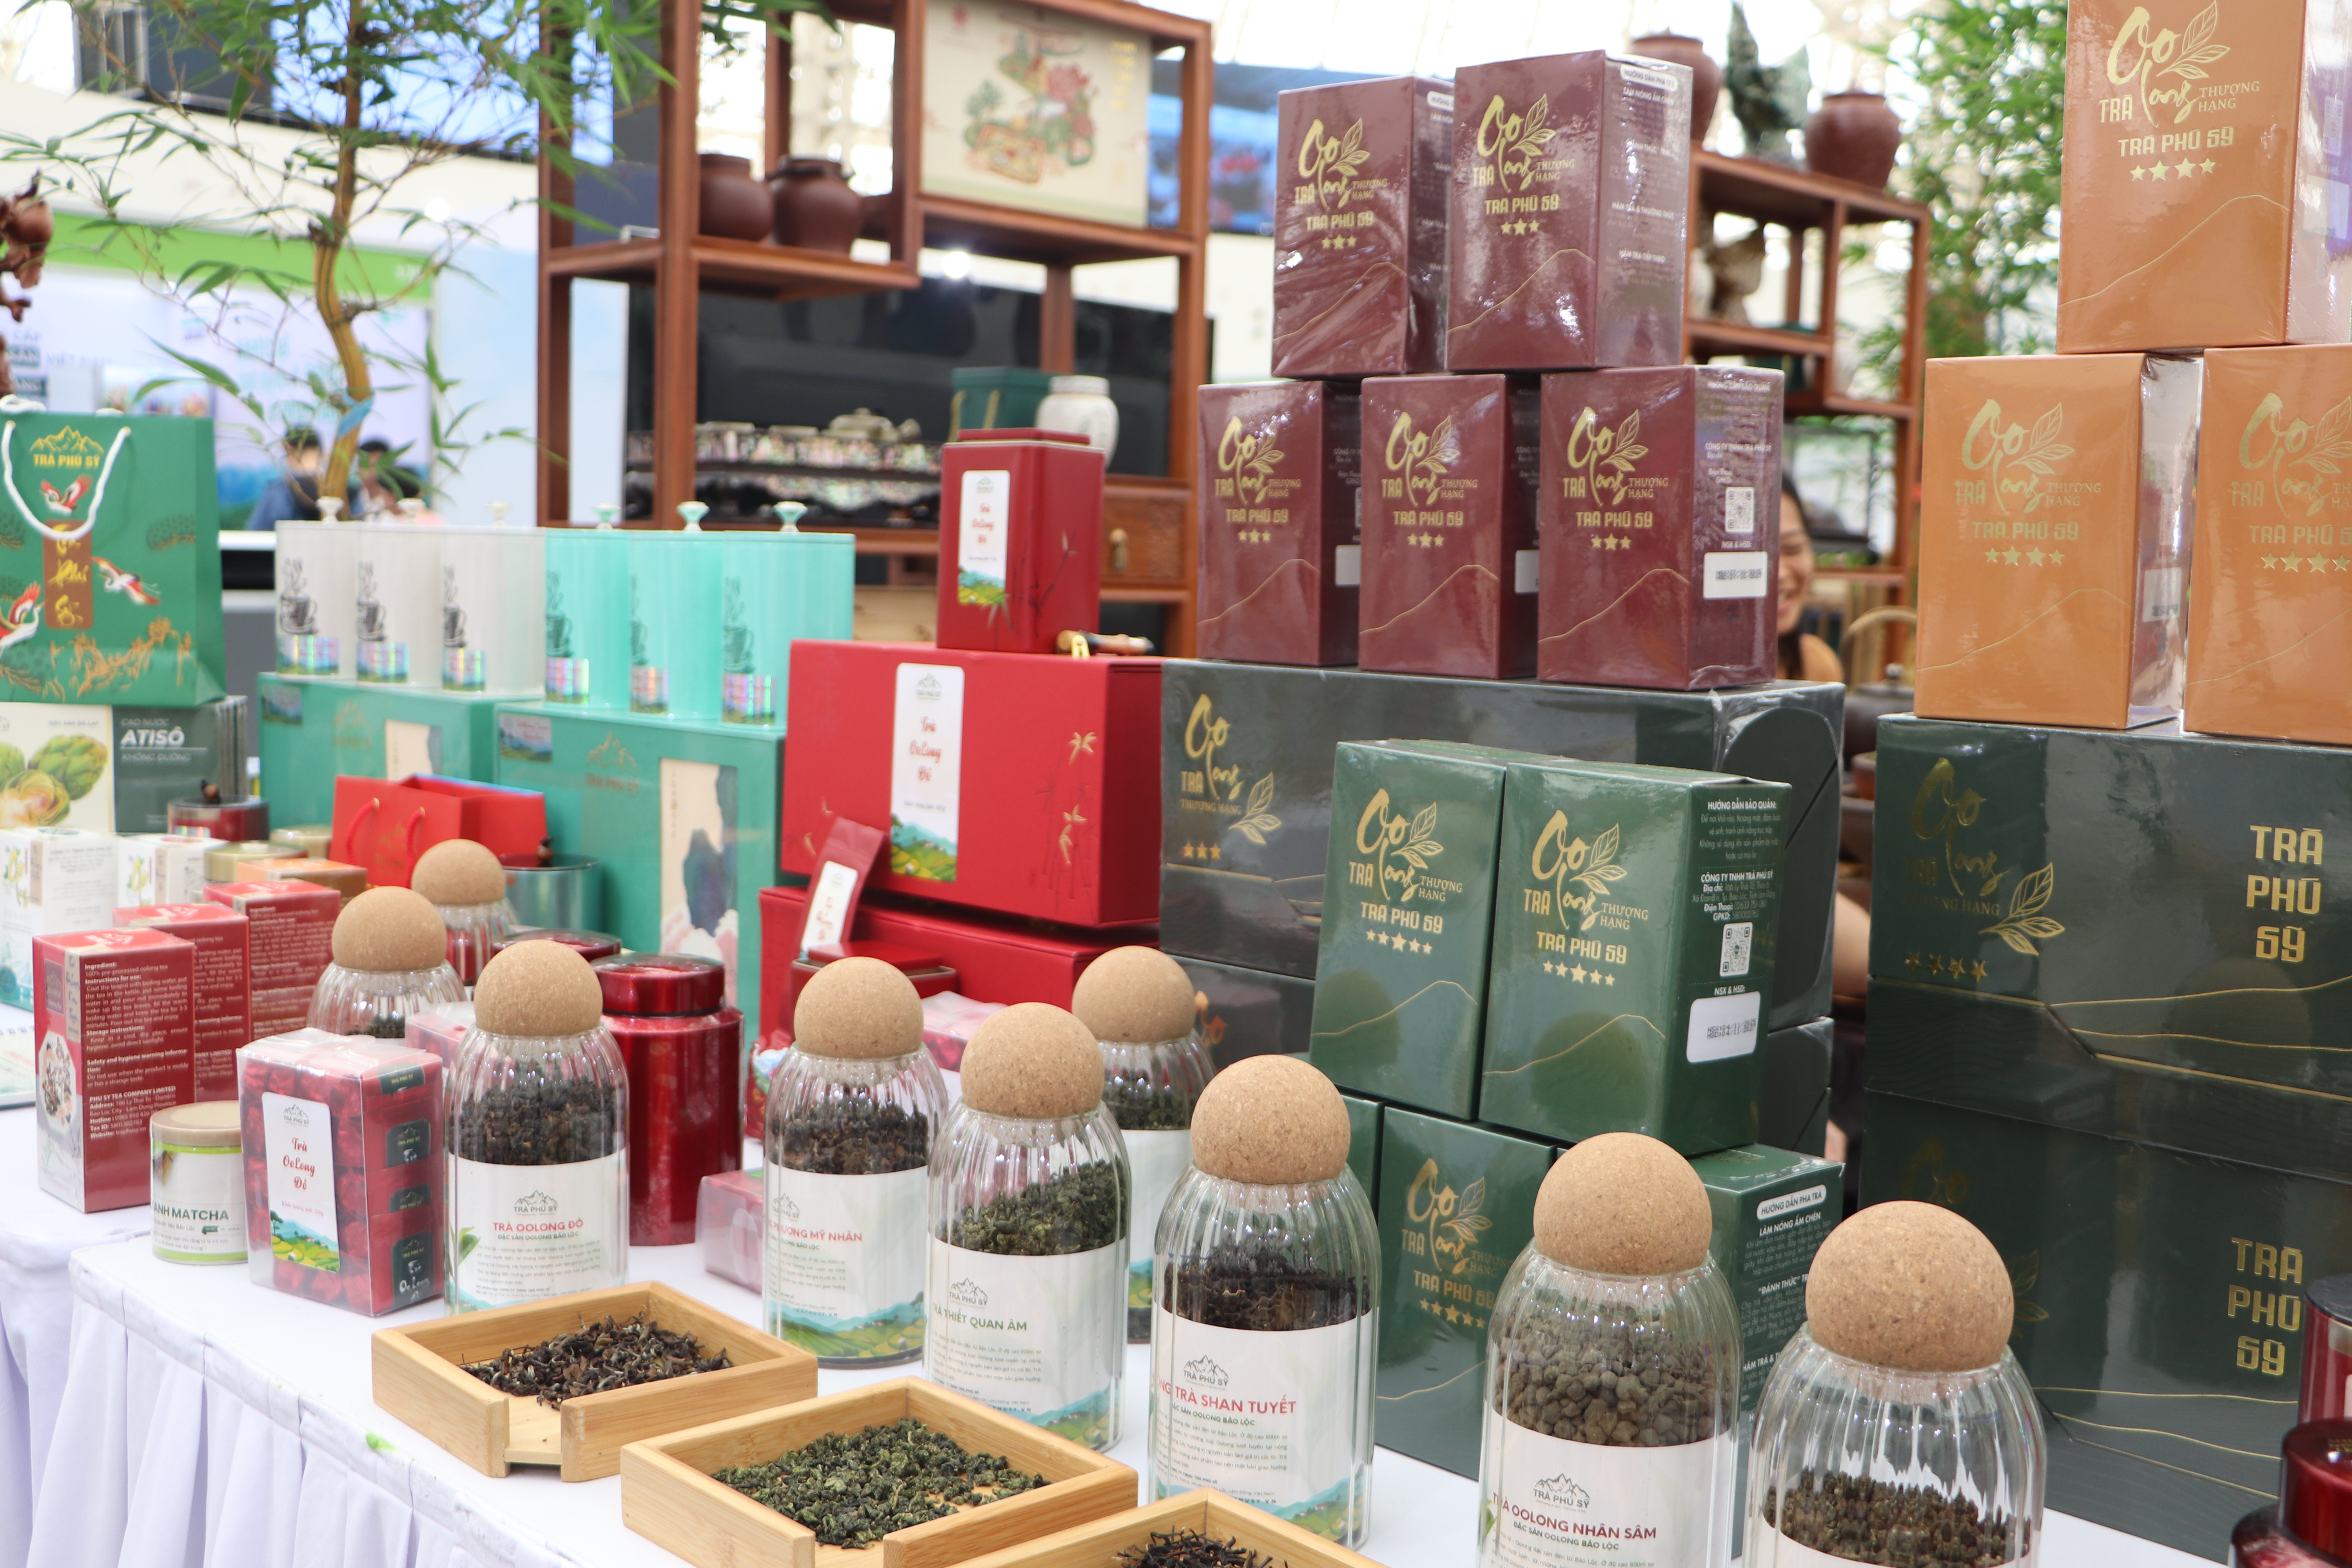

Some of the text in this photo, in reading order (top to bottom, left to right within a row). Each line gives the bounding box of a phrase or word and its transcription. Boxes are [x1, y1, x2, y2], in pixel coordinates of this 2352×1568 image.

[2199, 81, 2260, 98] THƯỢNG
[2198, 98, 2236, 113] HẠNG
[2047, 483, 2101, 493] THƯỢNG
[2046, 495, 2081, 507] HẠNG
[120, 726, 185, 747] ATISÔ
[1708, 797, 1777, 810] HƯỚNG DẪN BẢO QUẢN:
[1701, 872, 1720, 882] CÔNG
[1729, 873, 1744, 881] TNHH
[1746, 870, 1755, 880] TRÀ
[1756, 869, 1767, 879] PHÚ
[1767, 869, 1773, 878] SỸ
[1420, 875, 1463, 893] THƯỢNG
[1419, 887, 1446, 901] HẠNG
[1602, 902, 1648, 920] THƯỢNG
[1713, 913, 1730, 921] GPKD:
[1601, 915, 1630, 929] HẠNG
[85, 962, 117, 970] Ingredient:
[102, 967, 139, 976] pre-processed
[1733, 985, 1745, 993] HSD:
[110, 1025, 145, 1034] instructions:
[118, 1054, 140, 1063] hygiene
[123, 1089, 152, 1098] COMPANY
[153, 1085, 176, 1094] LIMITED
[116, 1127, 146, 1135] traphusy.vn
[292, 1137, 307, 1152] Trà
[283, 1155, 315, 1177] OoLong
[294, 1176, 307, 1190] Đỏ
[548, 1203, 557, 1211] SỸ
[1761, 1189, 1822, 1215] HƯỚNG DẪN PHA TRÀ
[172, 1207, 229, 1220] MATCHA
[493, 1217, 583, 1232] TRÀ OOLONG ĐỎ
[1760, 1210, 1821, 1236] LÀM NÓNG ẤM CHÉN
[810, 1230, 825, 1240] MỸ
[829, 1230, 862, 1241] NHÂN
[949, 1291, 987, 1306] TRÀ PHÚ SỸ
[944, 1308, 1027, 1330] THIẾT QUAN ÂM
[1183, 1369, 1229, 1387] TRÀ PHÚ SỸ
[1175, 1385, 1296, 1414] TRÀ SHAN TUYẾT
[1181, 1406, 1255, 1426] SẢN OOLONG BẢO LỘC
[1534, 1488, 1590, 1508] TRÀ PHÚ SỸ
[1512, 1504, 1656, 1539] OOLONG NHÂN SÂM
[1514, 1520, 1619, 1551] ĐẶC SẢN OOLONG BẢO LỘC
